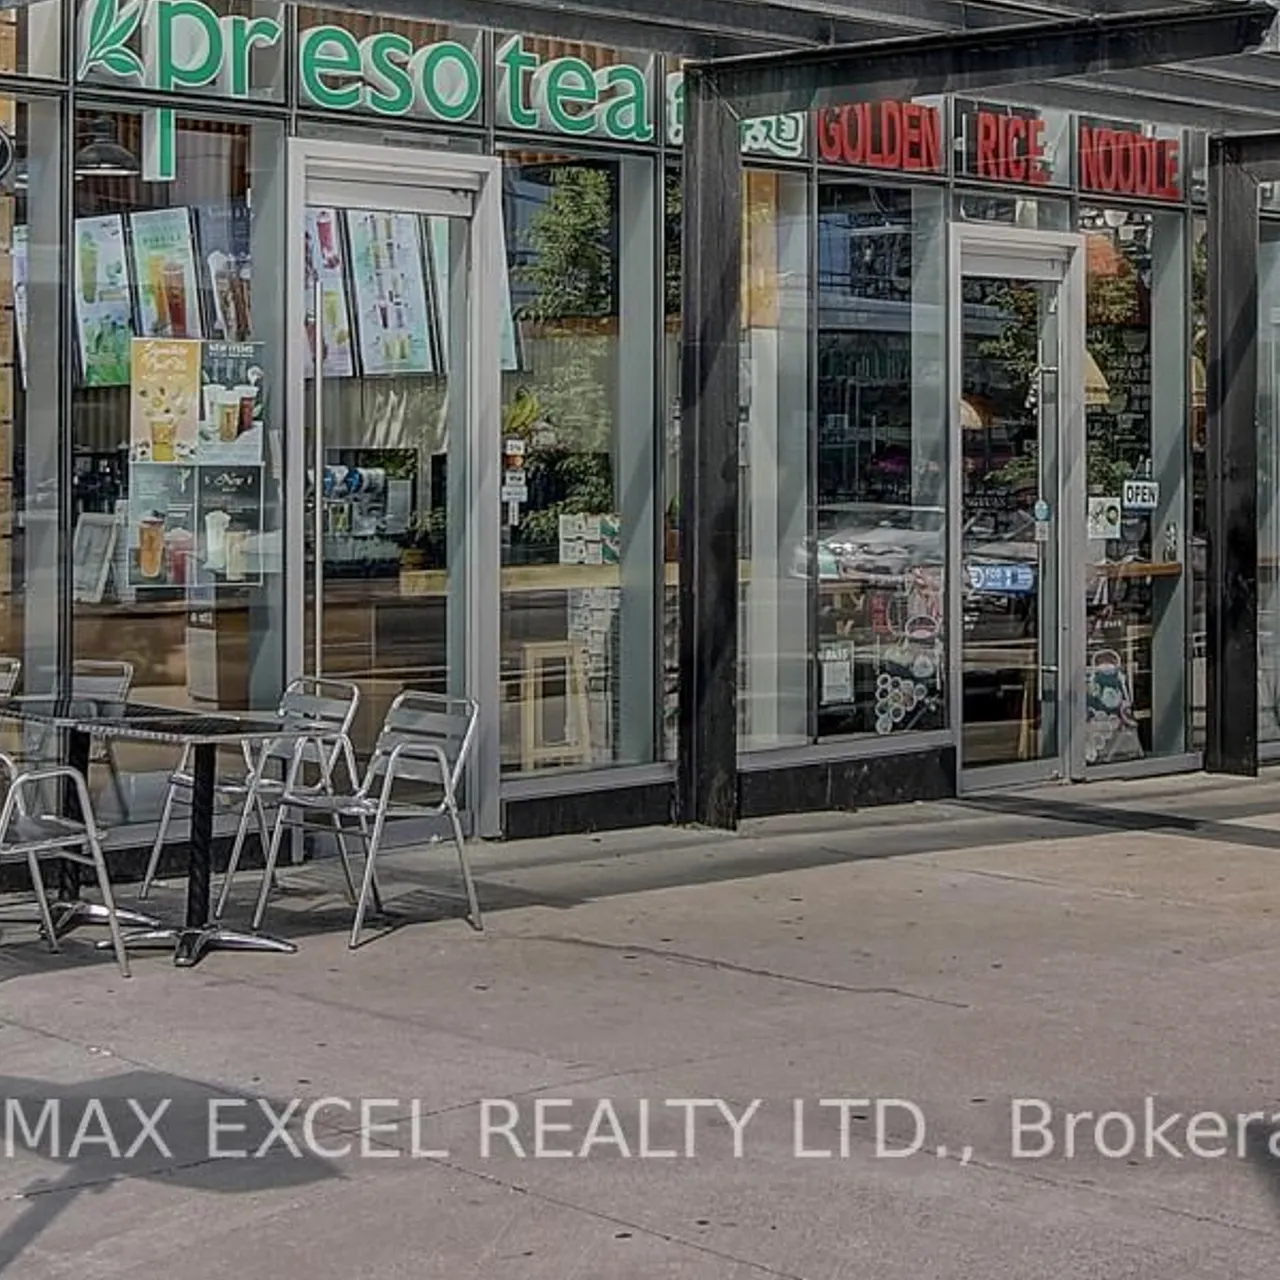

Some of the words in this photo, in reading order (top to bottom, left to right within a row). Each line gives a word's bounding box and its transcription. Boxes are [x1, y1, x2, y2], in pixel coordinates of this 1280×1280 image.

[816, 99, 943, 173] GOLDEN
[975, 110, 1051, 187] RICE
[1081, 126, 1183, 203] NOODLE
[1126, 485, 1157, 504] OPEN
